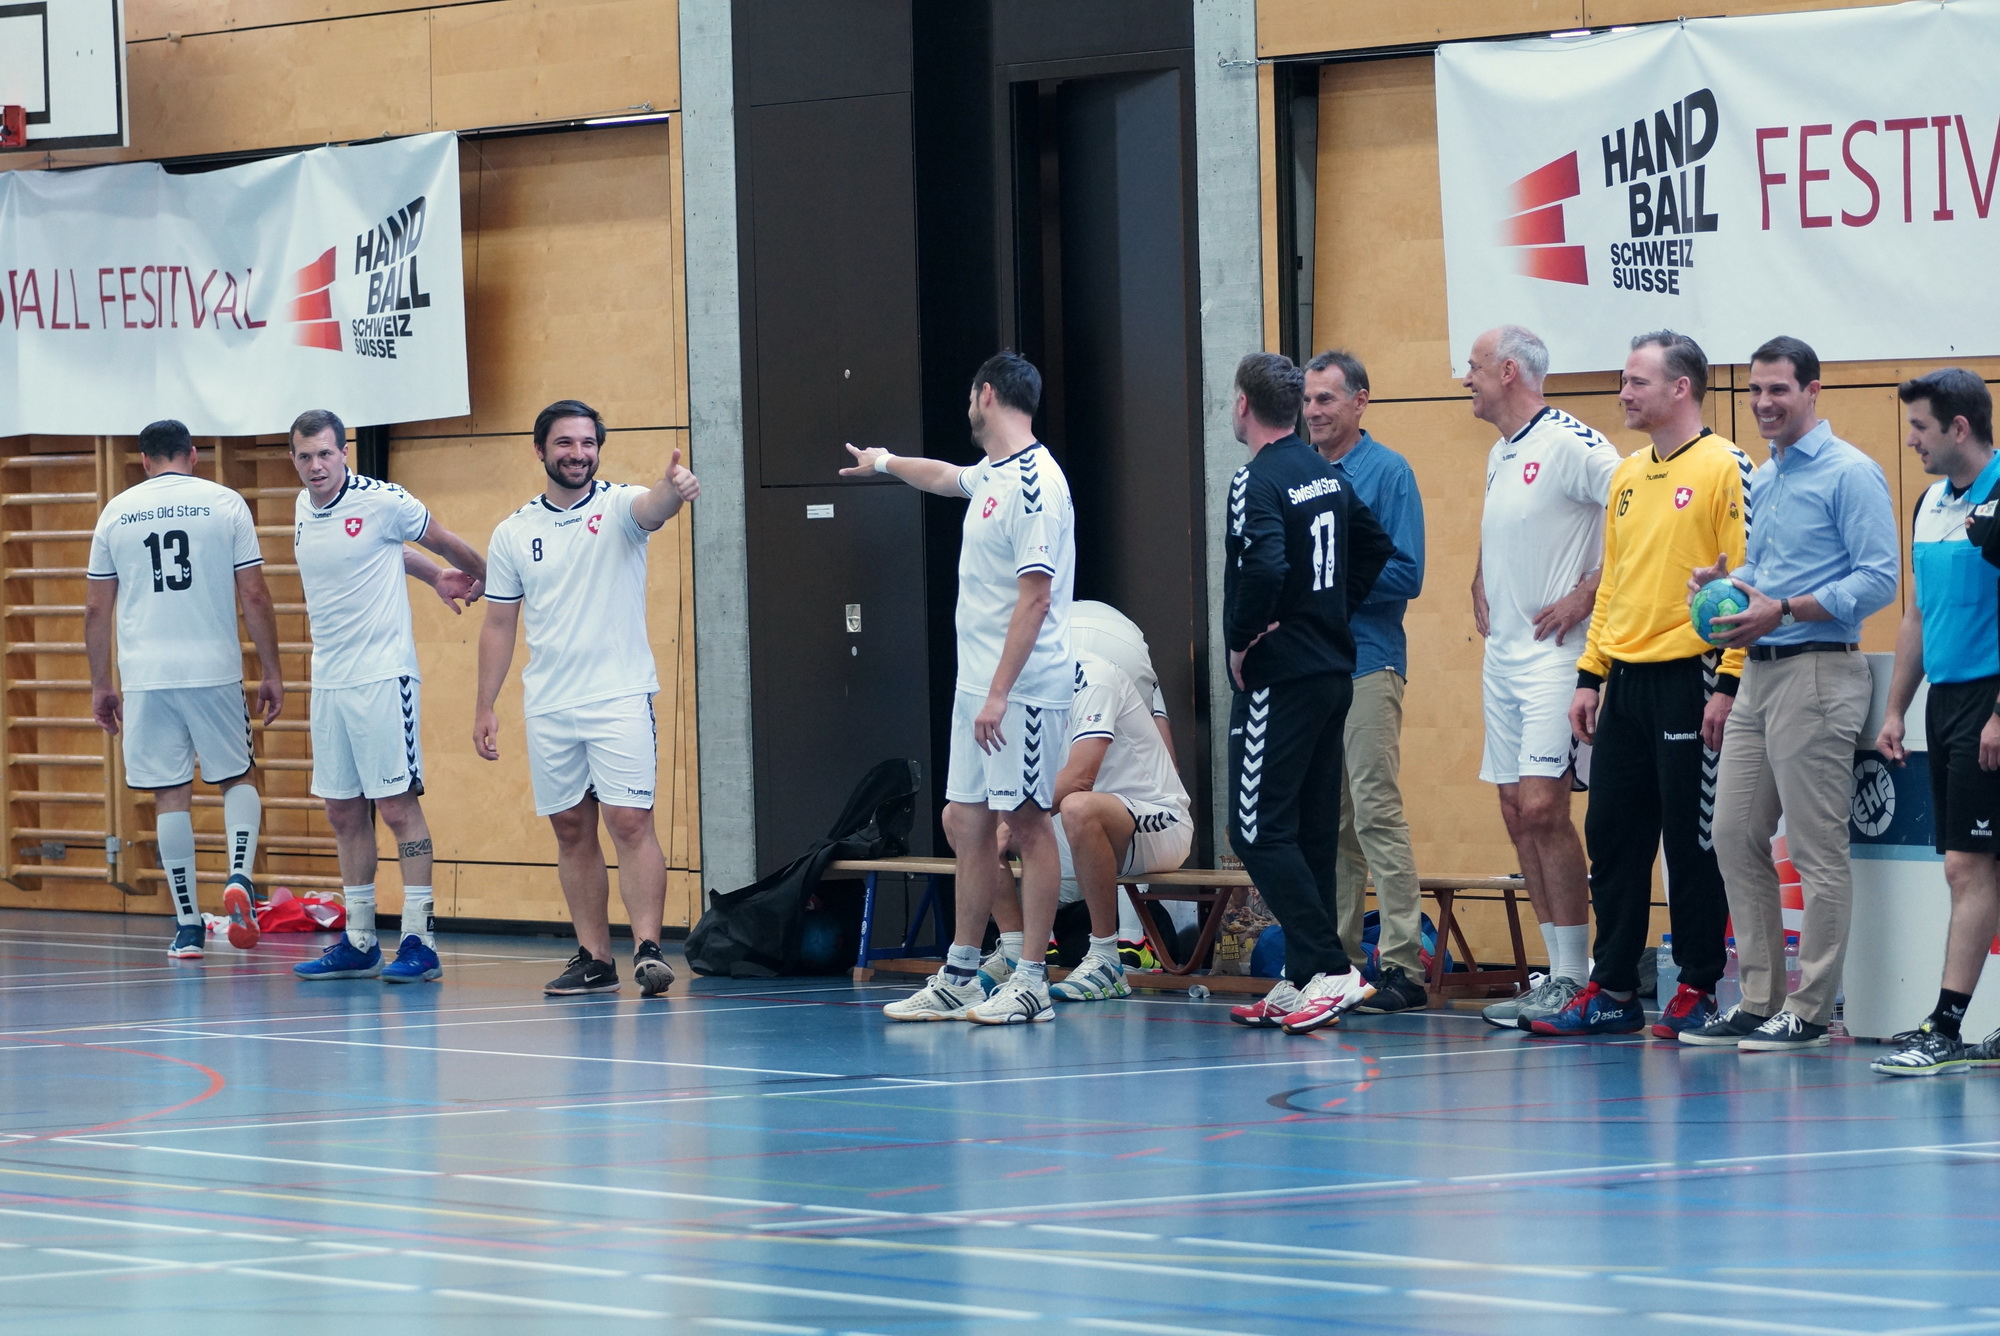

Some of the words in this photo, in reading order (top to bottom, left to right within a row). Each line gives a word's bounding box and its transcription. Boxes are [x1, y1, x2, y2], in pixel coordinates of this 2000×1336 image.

[1601, 87, 1720, 187] HAND
[1629, 164, 1718, 239] BALL
[355, 195, 426, 275] HAND
[1610, 237, 1694, 268] SCHWEIZ
[367, 255, 431, 315] BALL
[1613, 267, 1680, 296] SUISSE
[99, 265, 267, 330] FESTIVAL
[352, 313, 413, 338] SCHWEIZ
[355, 338, 397, 359] SUISSE
[1288, 484, 1315, 505] Swiss
[1616, 488, 1634, 517] 16
[120, 509, 154, 526] Swiss
[157, 505, 174, 519] Old
[177, 504, 210, 517] Stars
[554, 514, 583, 528] hummel
[143, 529, 192, 593] 13
[531, 537, 544, 562] 8
[1309, 510, 1336, 592] 17
[1664, 730, 1698, 741] hummel
[1529, 753, 1562, 765] hummel
[382, 773, 406, 785] hummel
[627, 786, 653, 797] hummel
[988, 787, 1018, 797] hummel
[1854, 768, 1890, 823] EHF
[1600, 1007, 1624, 1020] asics
